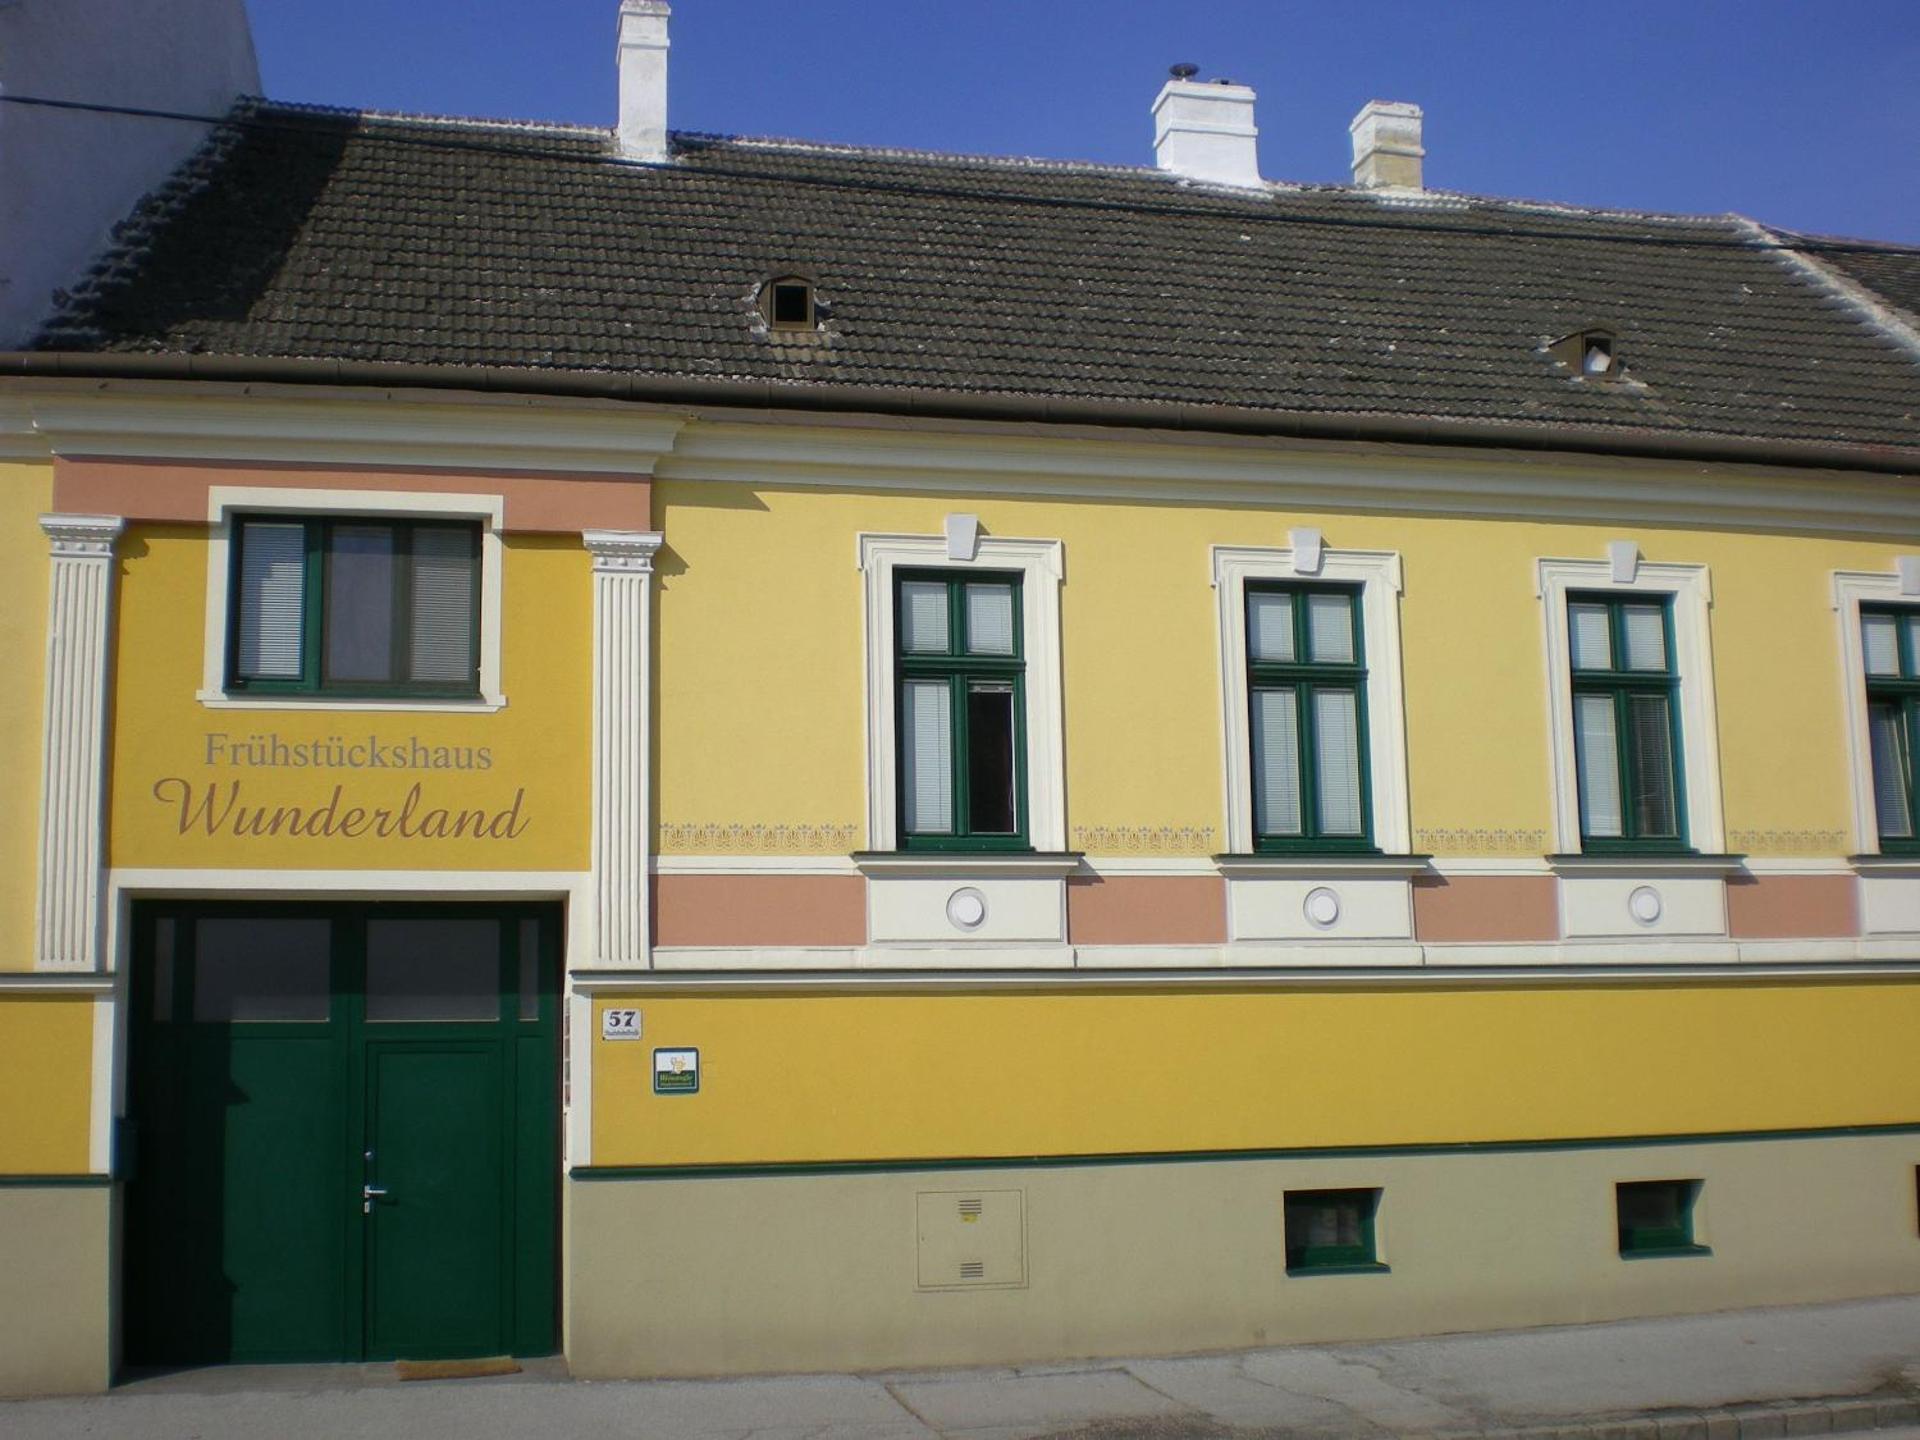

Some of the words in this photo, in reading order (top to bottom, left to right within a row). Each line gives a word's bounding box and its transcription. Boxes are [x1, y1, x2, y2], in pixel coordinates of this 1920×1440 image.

[206, 733, 491, 768] Frühstückshaus
[154, 778, 530, 839] Wunderland
[609, 1010, 636, 1027] 57
